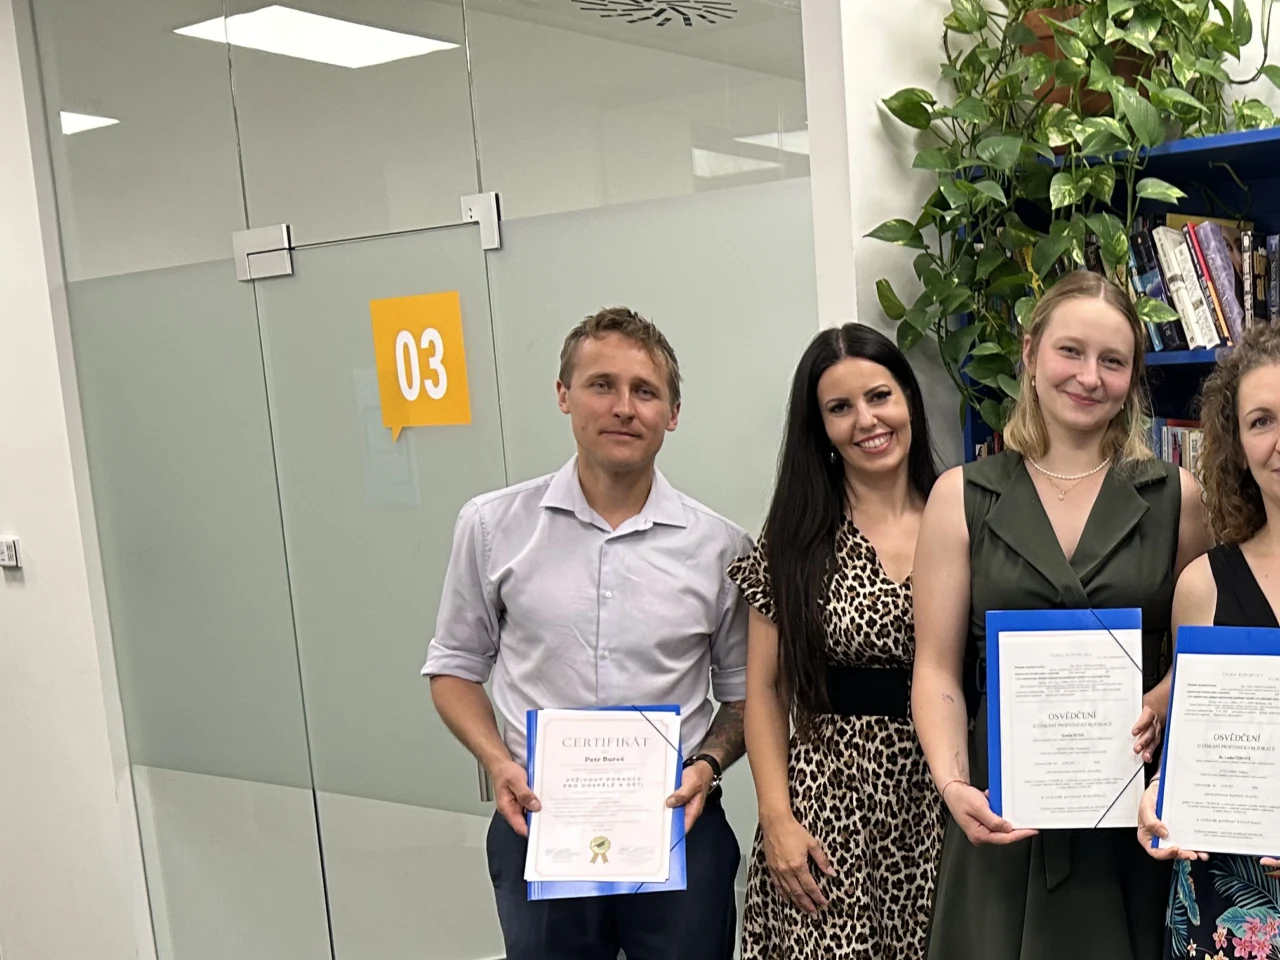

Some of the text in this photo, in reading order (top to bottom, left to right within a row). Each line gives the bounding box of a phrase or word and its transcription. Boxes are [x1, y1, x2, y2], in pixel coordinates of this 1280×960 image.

[395, 327, 448, 402] 03
[1048, 710, 1096, 721] OSVĚDČENÍ
[562, 736, 649, 748] CERTIFIKÁT
[1213, 732, 1261, 743] OSVĚDČENÍ
